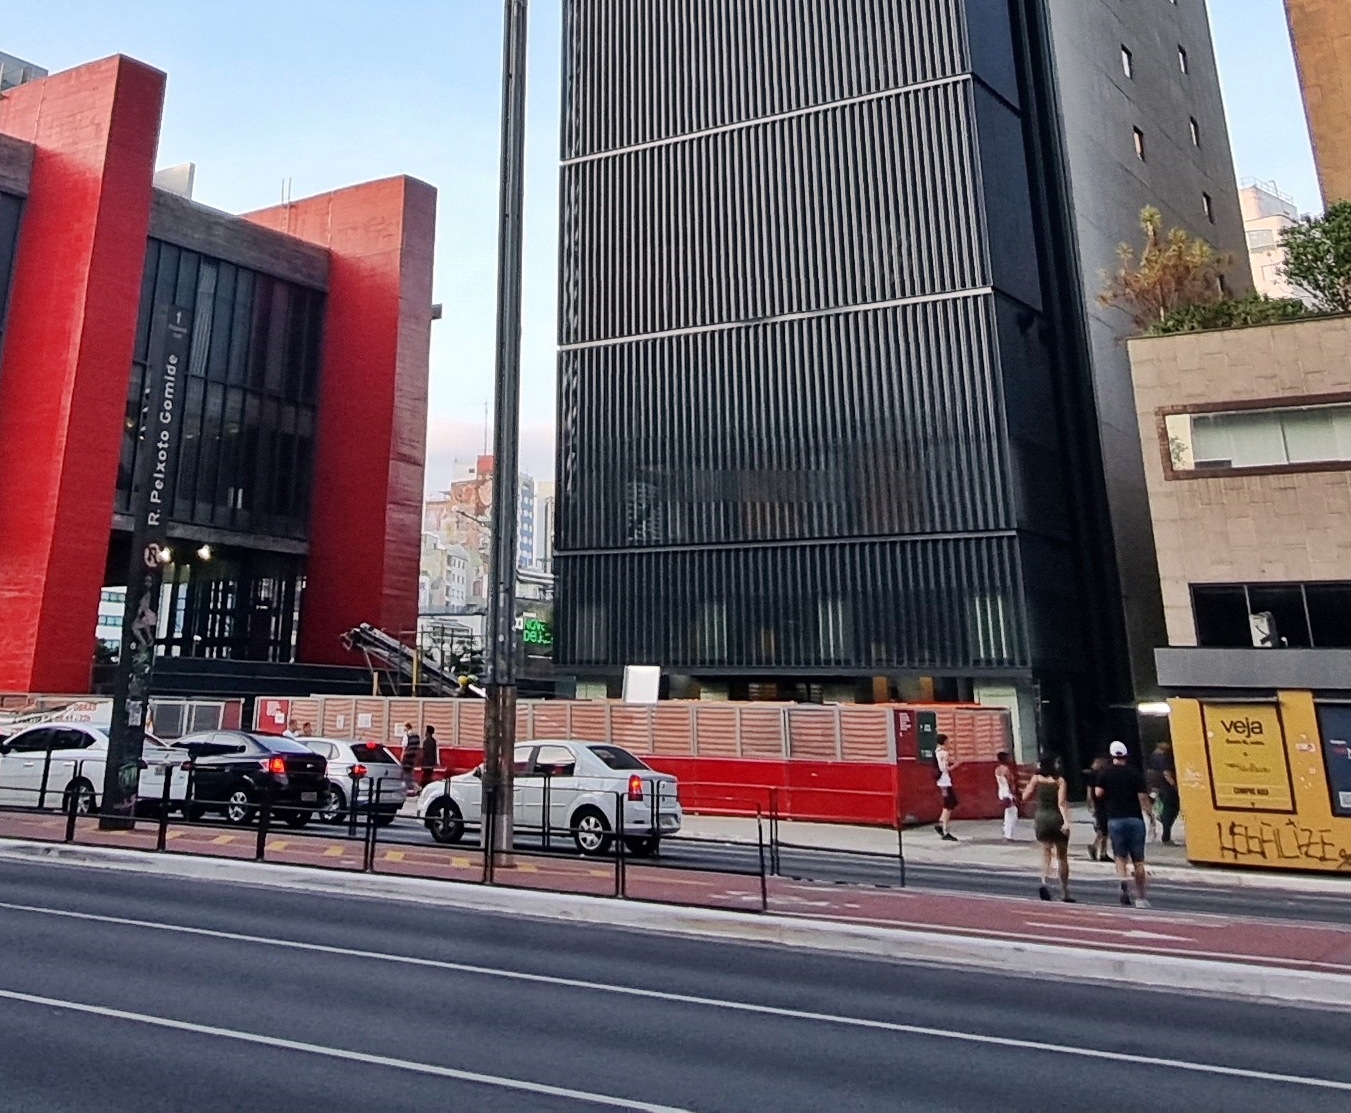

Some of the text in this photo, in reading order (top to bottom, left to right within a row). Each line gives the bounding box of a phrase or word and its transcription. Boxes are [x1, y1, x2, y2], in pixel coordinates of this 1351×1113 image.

[159, 354, 179, 424] Gomide
[149, 430, 170, 504] Peixoto
[147, 508, 161, 526] R.
[1220, 716, 1264, 739] veja
